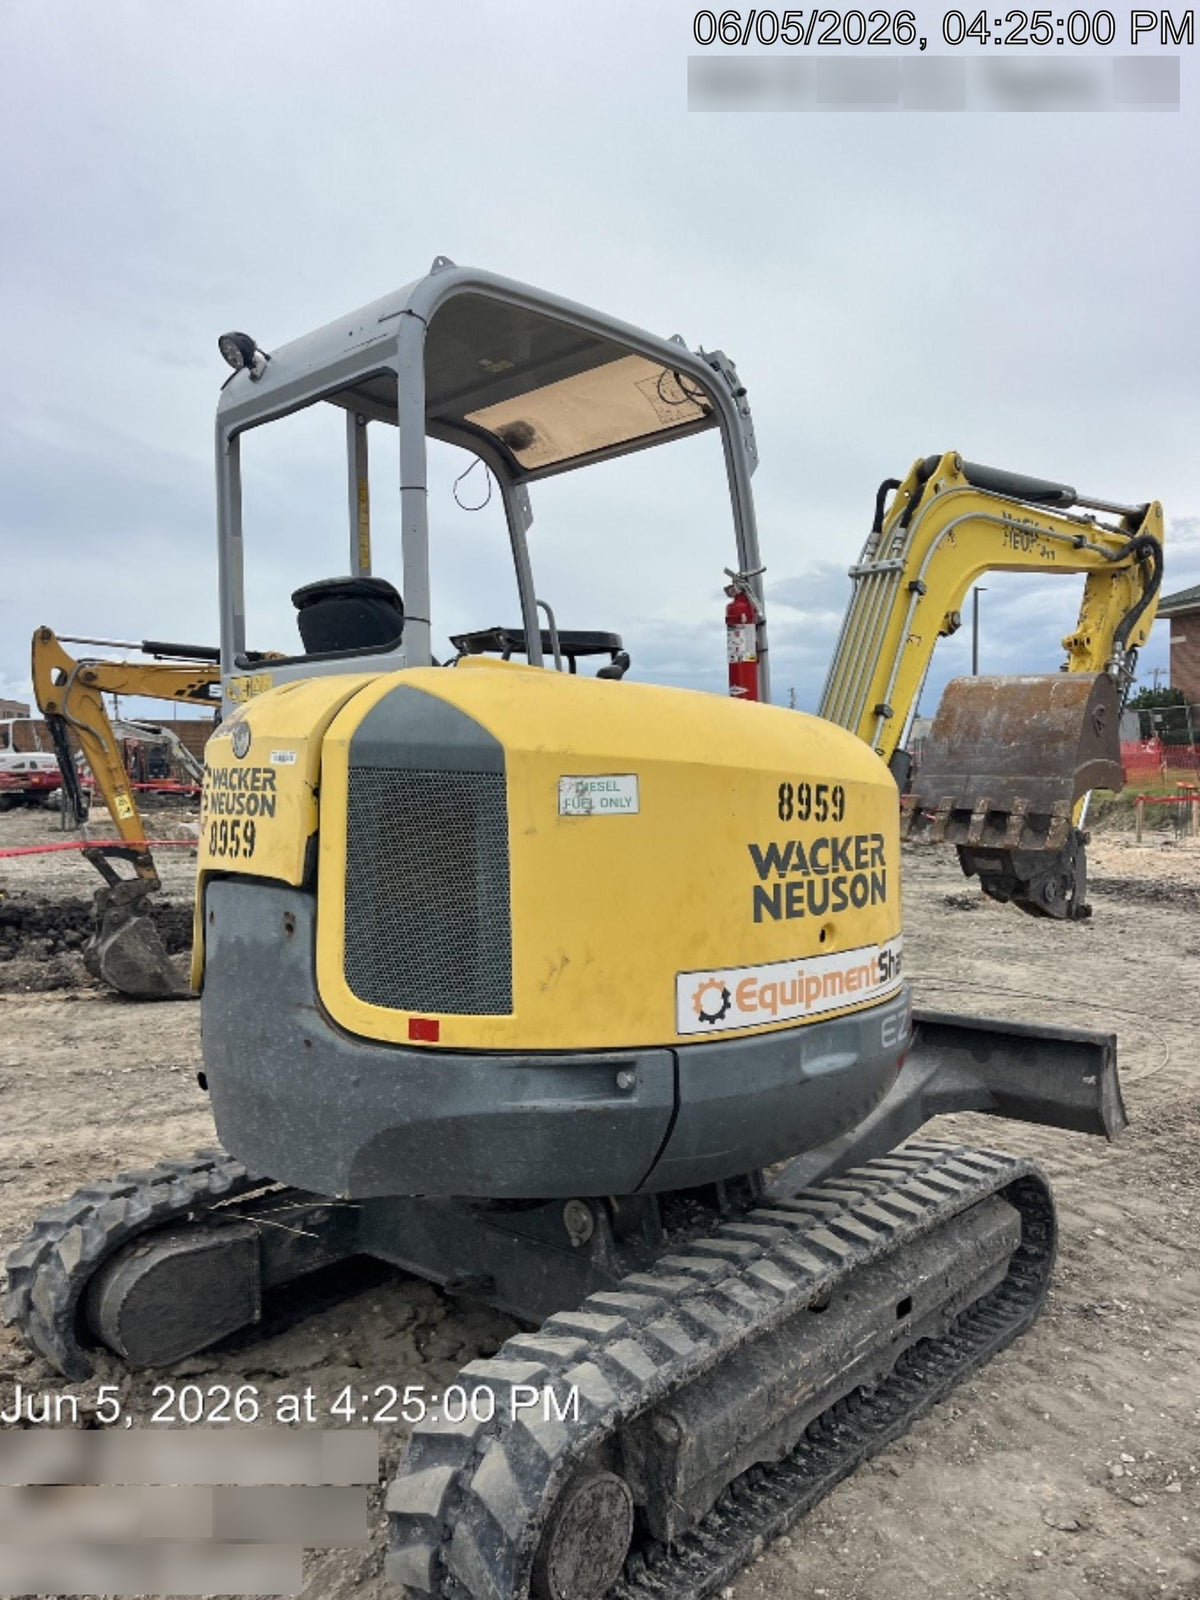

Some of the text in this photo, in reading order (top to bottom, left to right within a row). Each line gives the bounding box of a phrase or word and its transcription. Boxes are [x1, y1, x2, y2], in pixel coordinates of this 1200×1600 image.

[212, 767, 276, 792] WACKER
[575, 781, 621, 794] DIESEL
[210, 792, 276, 818] NEUSON
[600, 797, 632, 808] ONLY
[778, 782, 845, 822] 8959
[748, 833, 886, 880] WACKER
[753, 869, 887, 923] NEUSON
